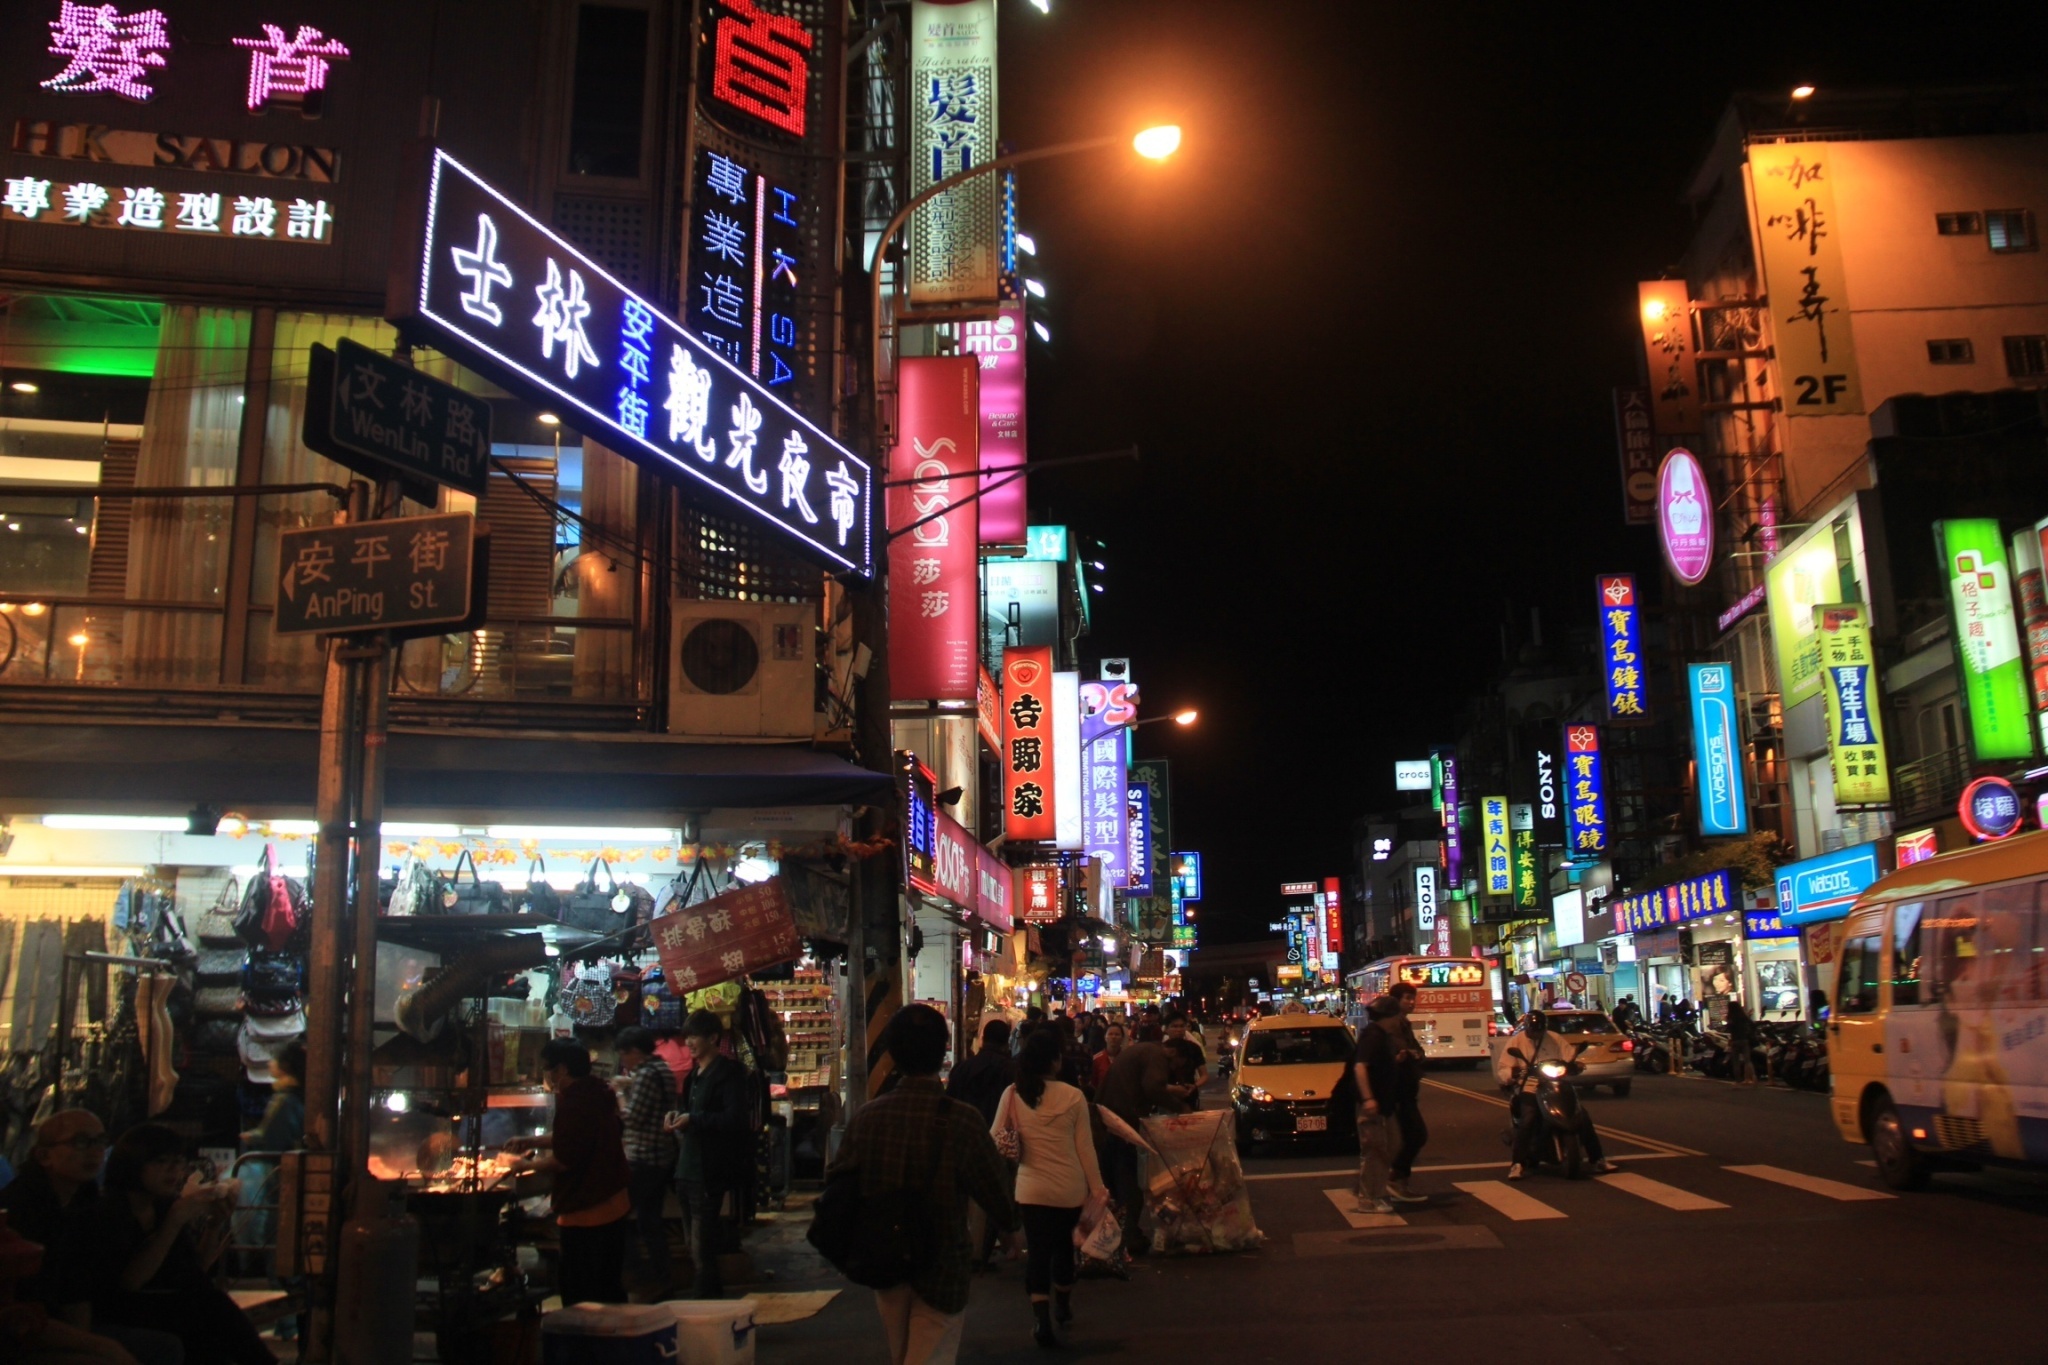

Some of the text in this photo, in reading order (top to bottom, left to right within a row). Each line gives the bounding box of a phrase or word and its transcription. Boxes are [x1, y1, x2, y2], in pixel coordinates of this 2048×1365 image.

[13, 118, 339, 183] HK SALON
[926, 73, 978, 181] 髮首
[2, 175, 333, 242] 專業造型設計
[353, 363, 477, 446] 文林路
[452, 212, 860, 547] 士林 安平街 觀光夜市
[1794, 374, 1848, 407] 2F
[350, 407, 430, 461] WenLin
[297, 530, 450, 587] 安平街
[305, 588, 385, 624] AnPing
[913, 558, 949, 619] 莎莎
[1608, 608, 1643, 715] 寶島鐘錶
[1829, 636, 1863, 648] 二手
[1832, 649, 1865, 662] 物品
[1702, 673, 1720, 685] 24
[1838, 667, 1868, 743] 再生工場
[1010, 694, 1043, 819] 吉野家
[1398, 770, 1430, 780] crocs
[1537, 750, 1557, 820] SONY
[1093, 738, 1119, 846] 國際髮型
[1573, 753, 1605, 851] 寶島眼鏡
[1975, 795, 2016, 819] 塔羅
[1487, 799, 1508, 890] 年青人眼鏡
[1516, 831, 1537, 907] 得安藥局
[1420, 873, 1433, 923] crocs
[1747, 916, 1784, 932] 寶島鐘
[661, 909, 734, 950] 排骨酥
[1437, 918, 1450, 956] 皮膚專
[1420, 993, 1467, 1004] 209-FU
